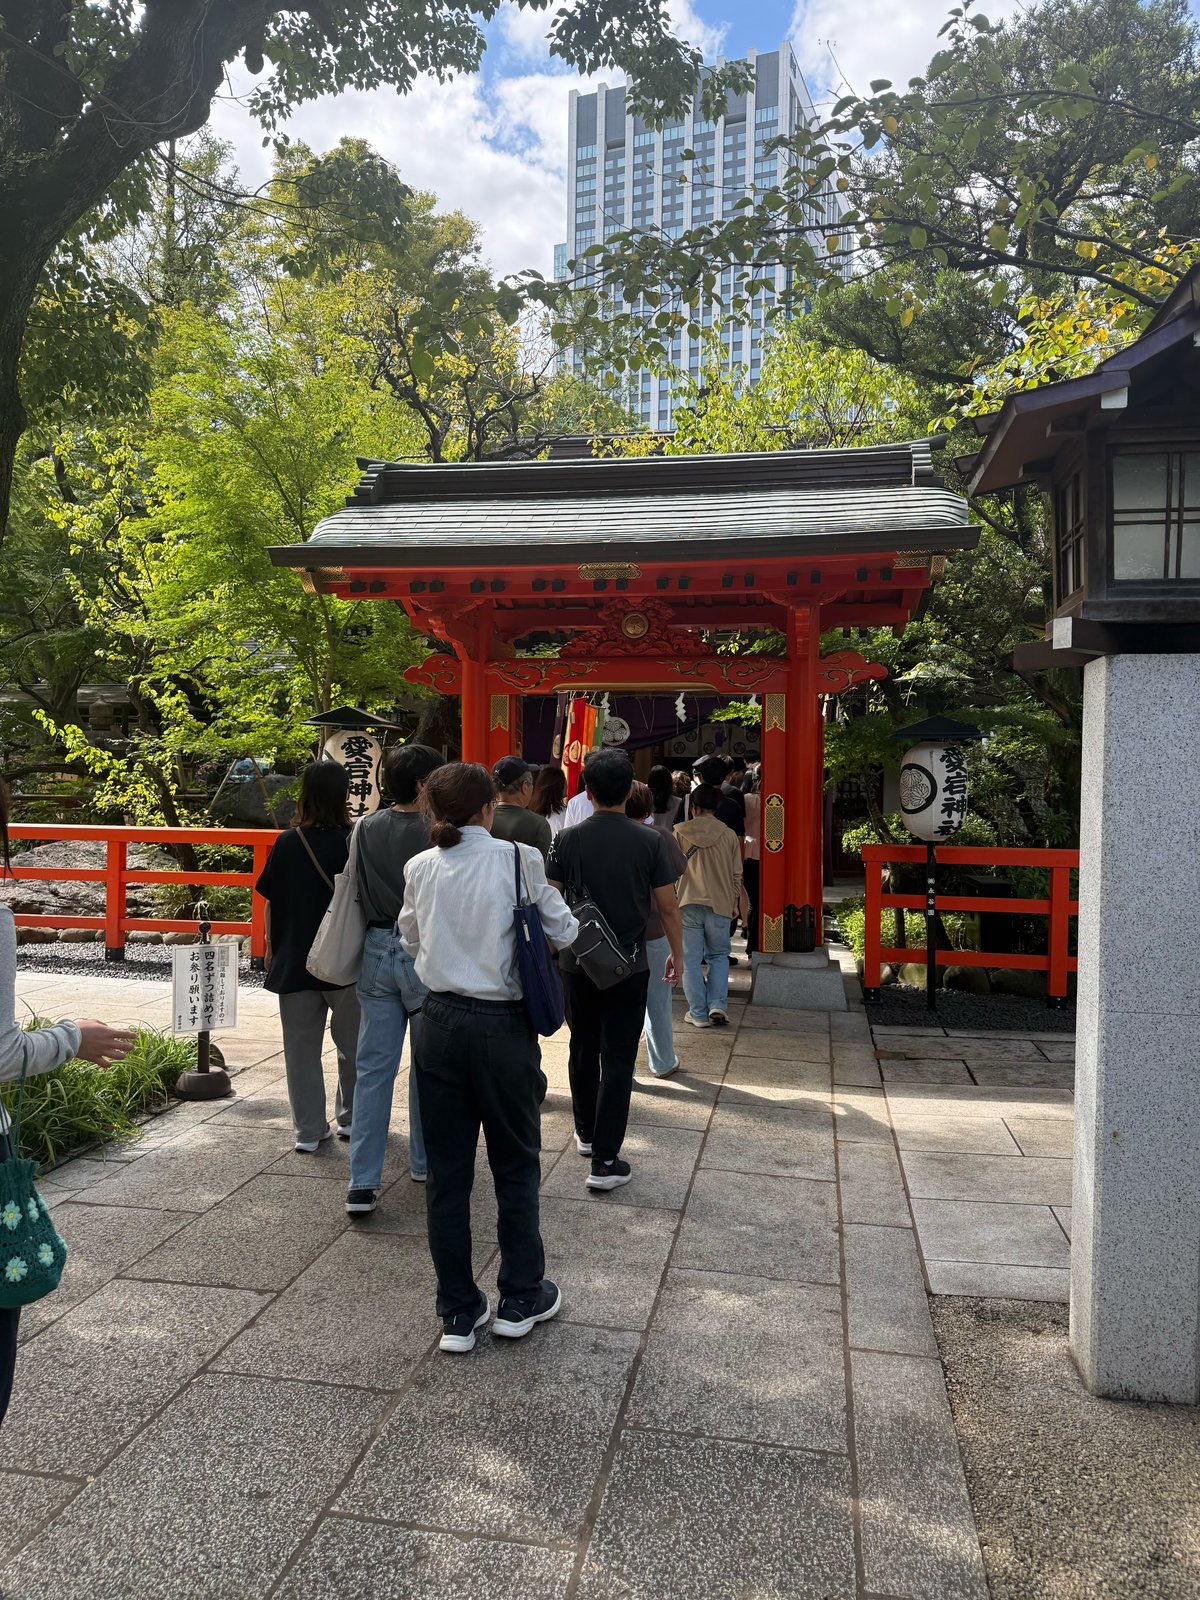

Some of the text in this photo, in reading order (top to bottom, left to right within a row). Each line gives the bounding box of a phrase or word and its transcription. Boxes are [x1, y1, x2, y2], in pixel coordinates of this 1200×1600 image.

[933, 746, 967, 836] 愛宕神社
[189, 951, 200, 1026] お参り願います
[204, 951, 215, 1024] 四名ずつ詰めて
